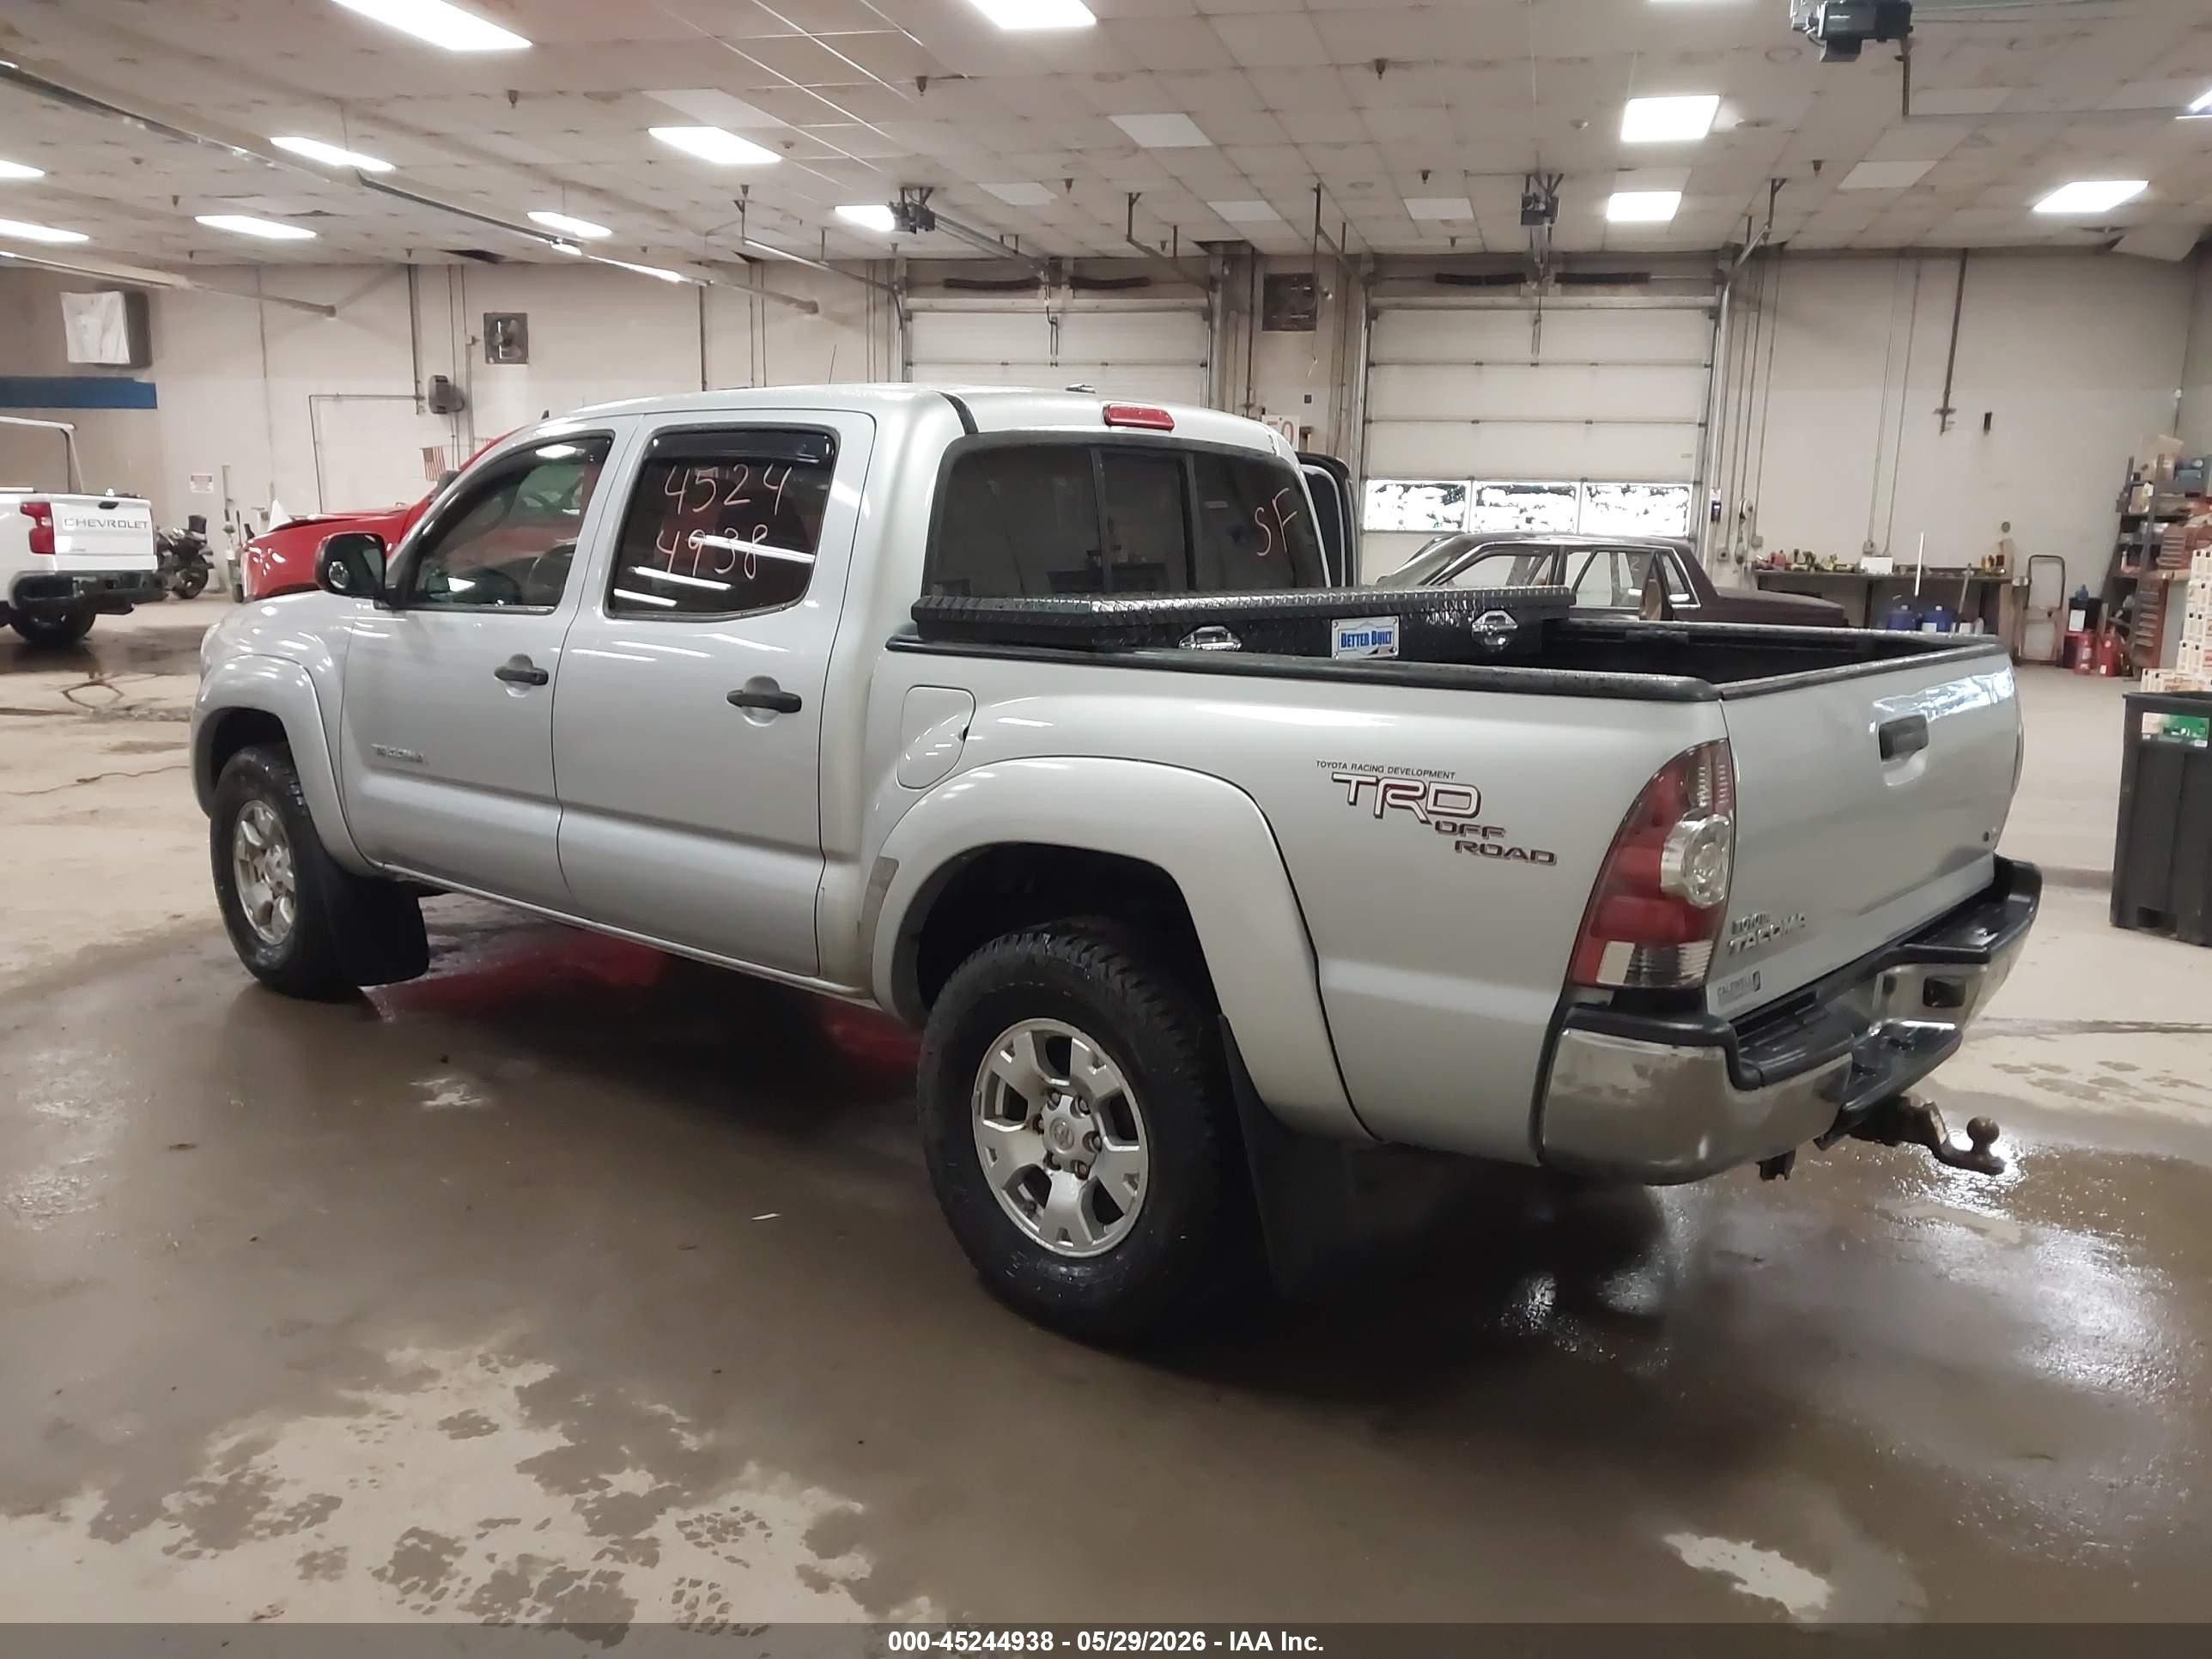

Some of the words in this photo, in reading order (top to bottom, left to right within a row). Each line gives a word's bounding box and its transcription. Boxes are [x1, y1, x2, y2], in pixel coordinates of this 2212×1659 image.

[664, 464, 793, 515] 4524
[64, 518, 149, 529] CHEVROLET
[1255, 488, 1297, 556] SF
[656, 524, 769, 580] 4938
[1316, 761, 1348, 770] TOYOTA
[1351, 763, 1384, 774] RACING
[1387, 766, 1456, 780] DEVELOPMENT
[1332, 772, 1481, 824] TRD
[1434, 819, 1507, 840] OFF
[1454, 840, 1558, 866] ROAD
